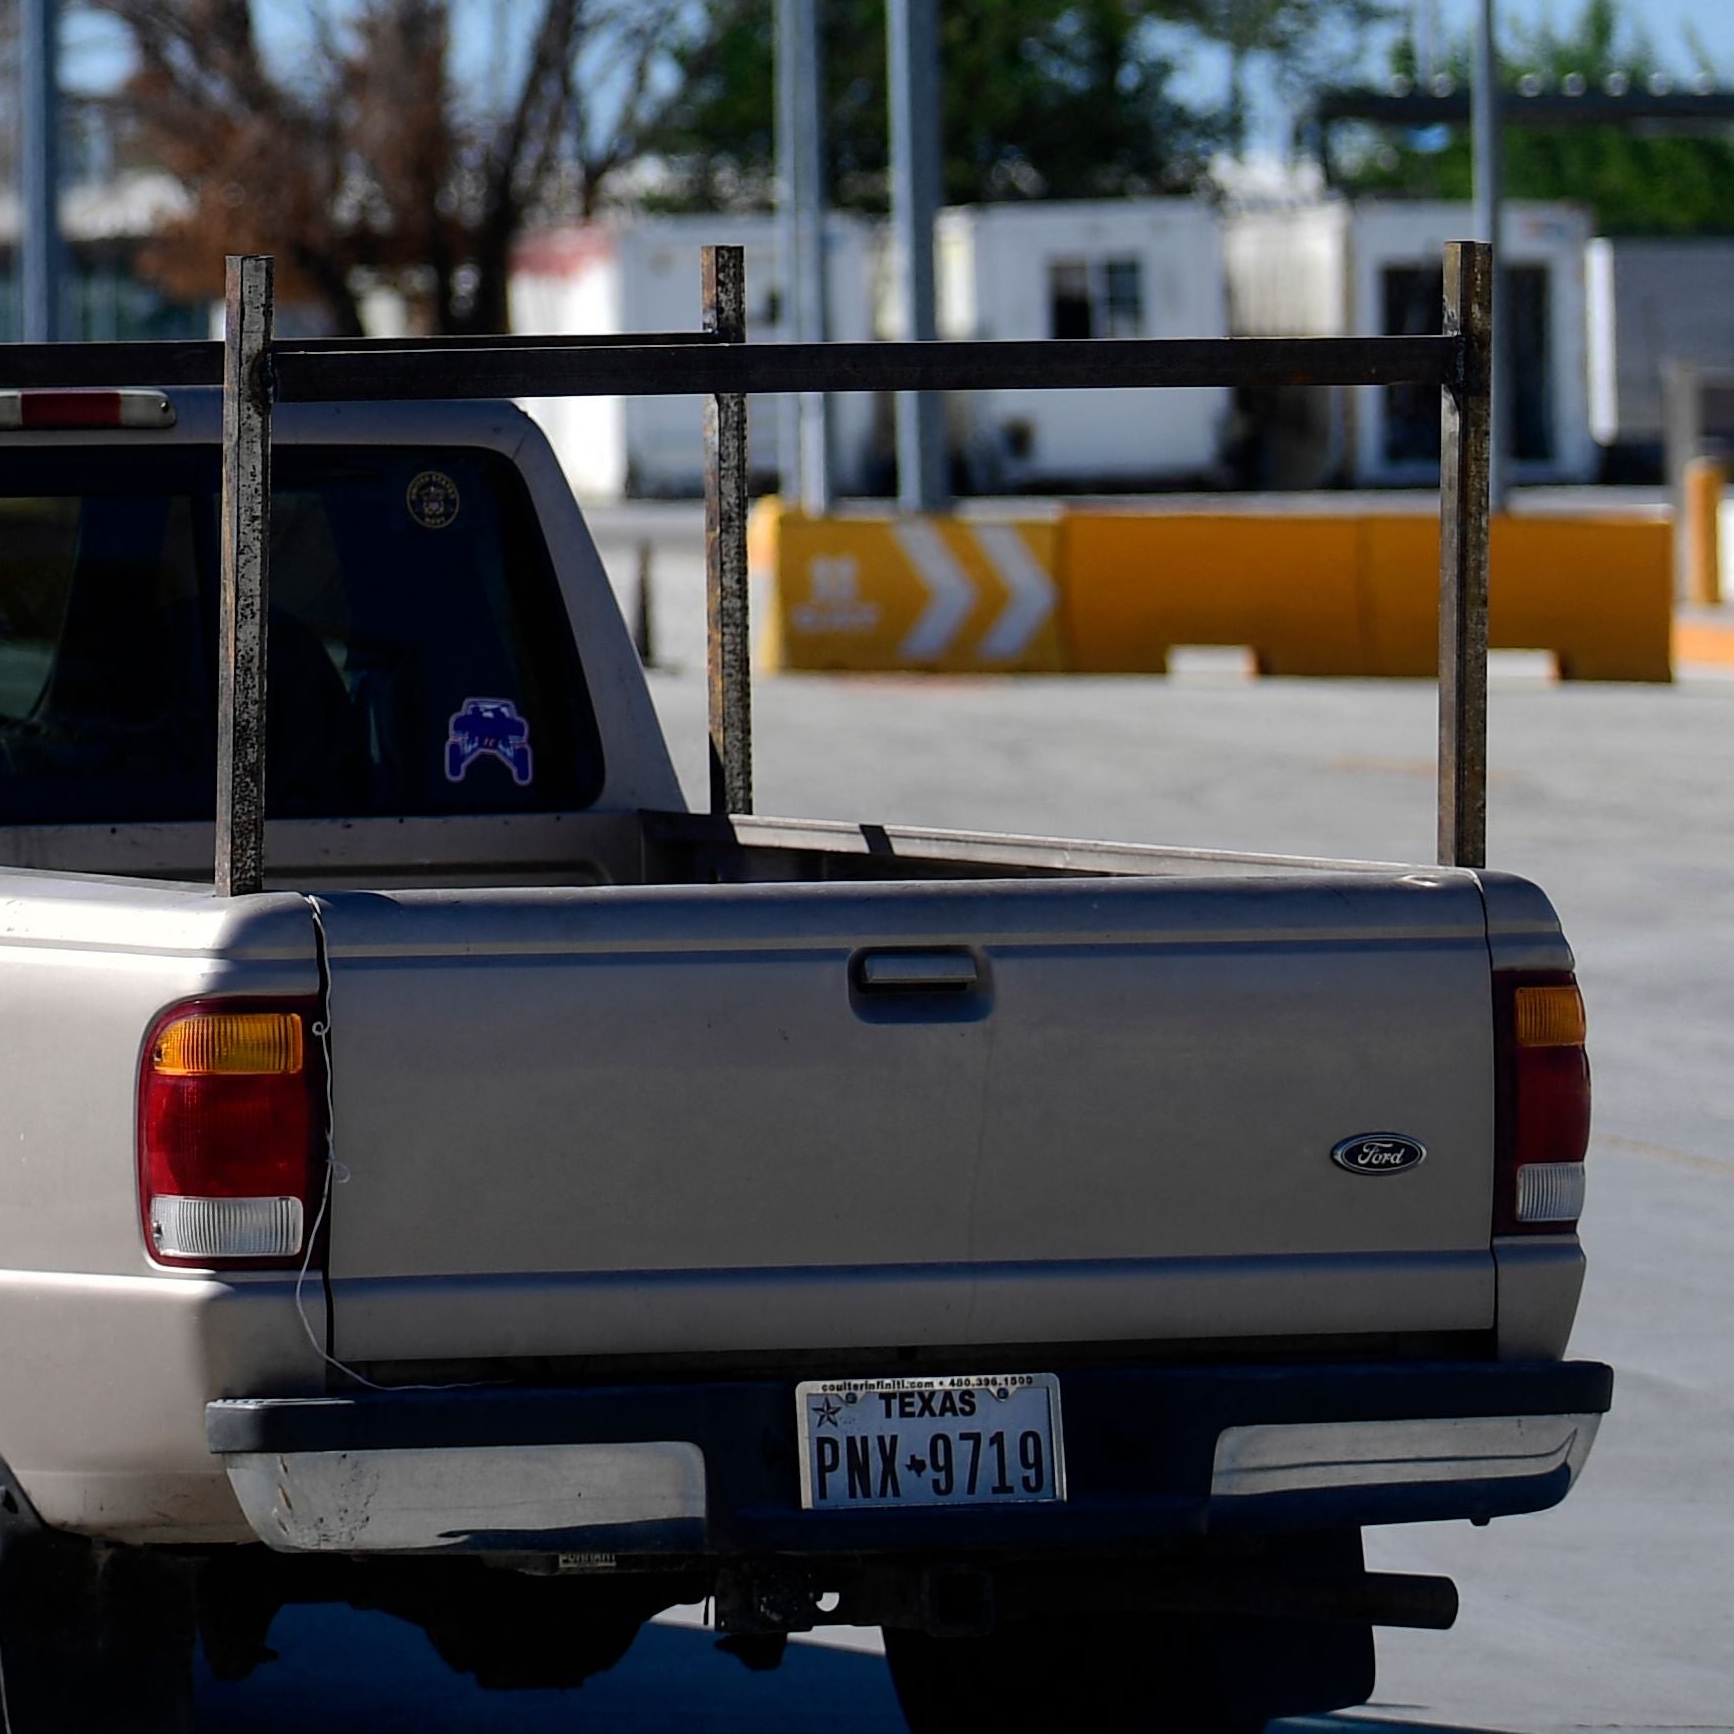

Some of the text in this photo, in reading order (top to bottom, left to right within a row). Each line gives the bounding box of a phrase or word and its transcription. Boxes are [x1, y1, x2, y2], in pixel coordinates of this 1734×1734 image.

[1357, 1142, 1405, 1164] Ford
[879, 1390, 977, 1419] TEXAS
[816, 1430, 1044, 1499] PNX 9719
